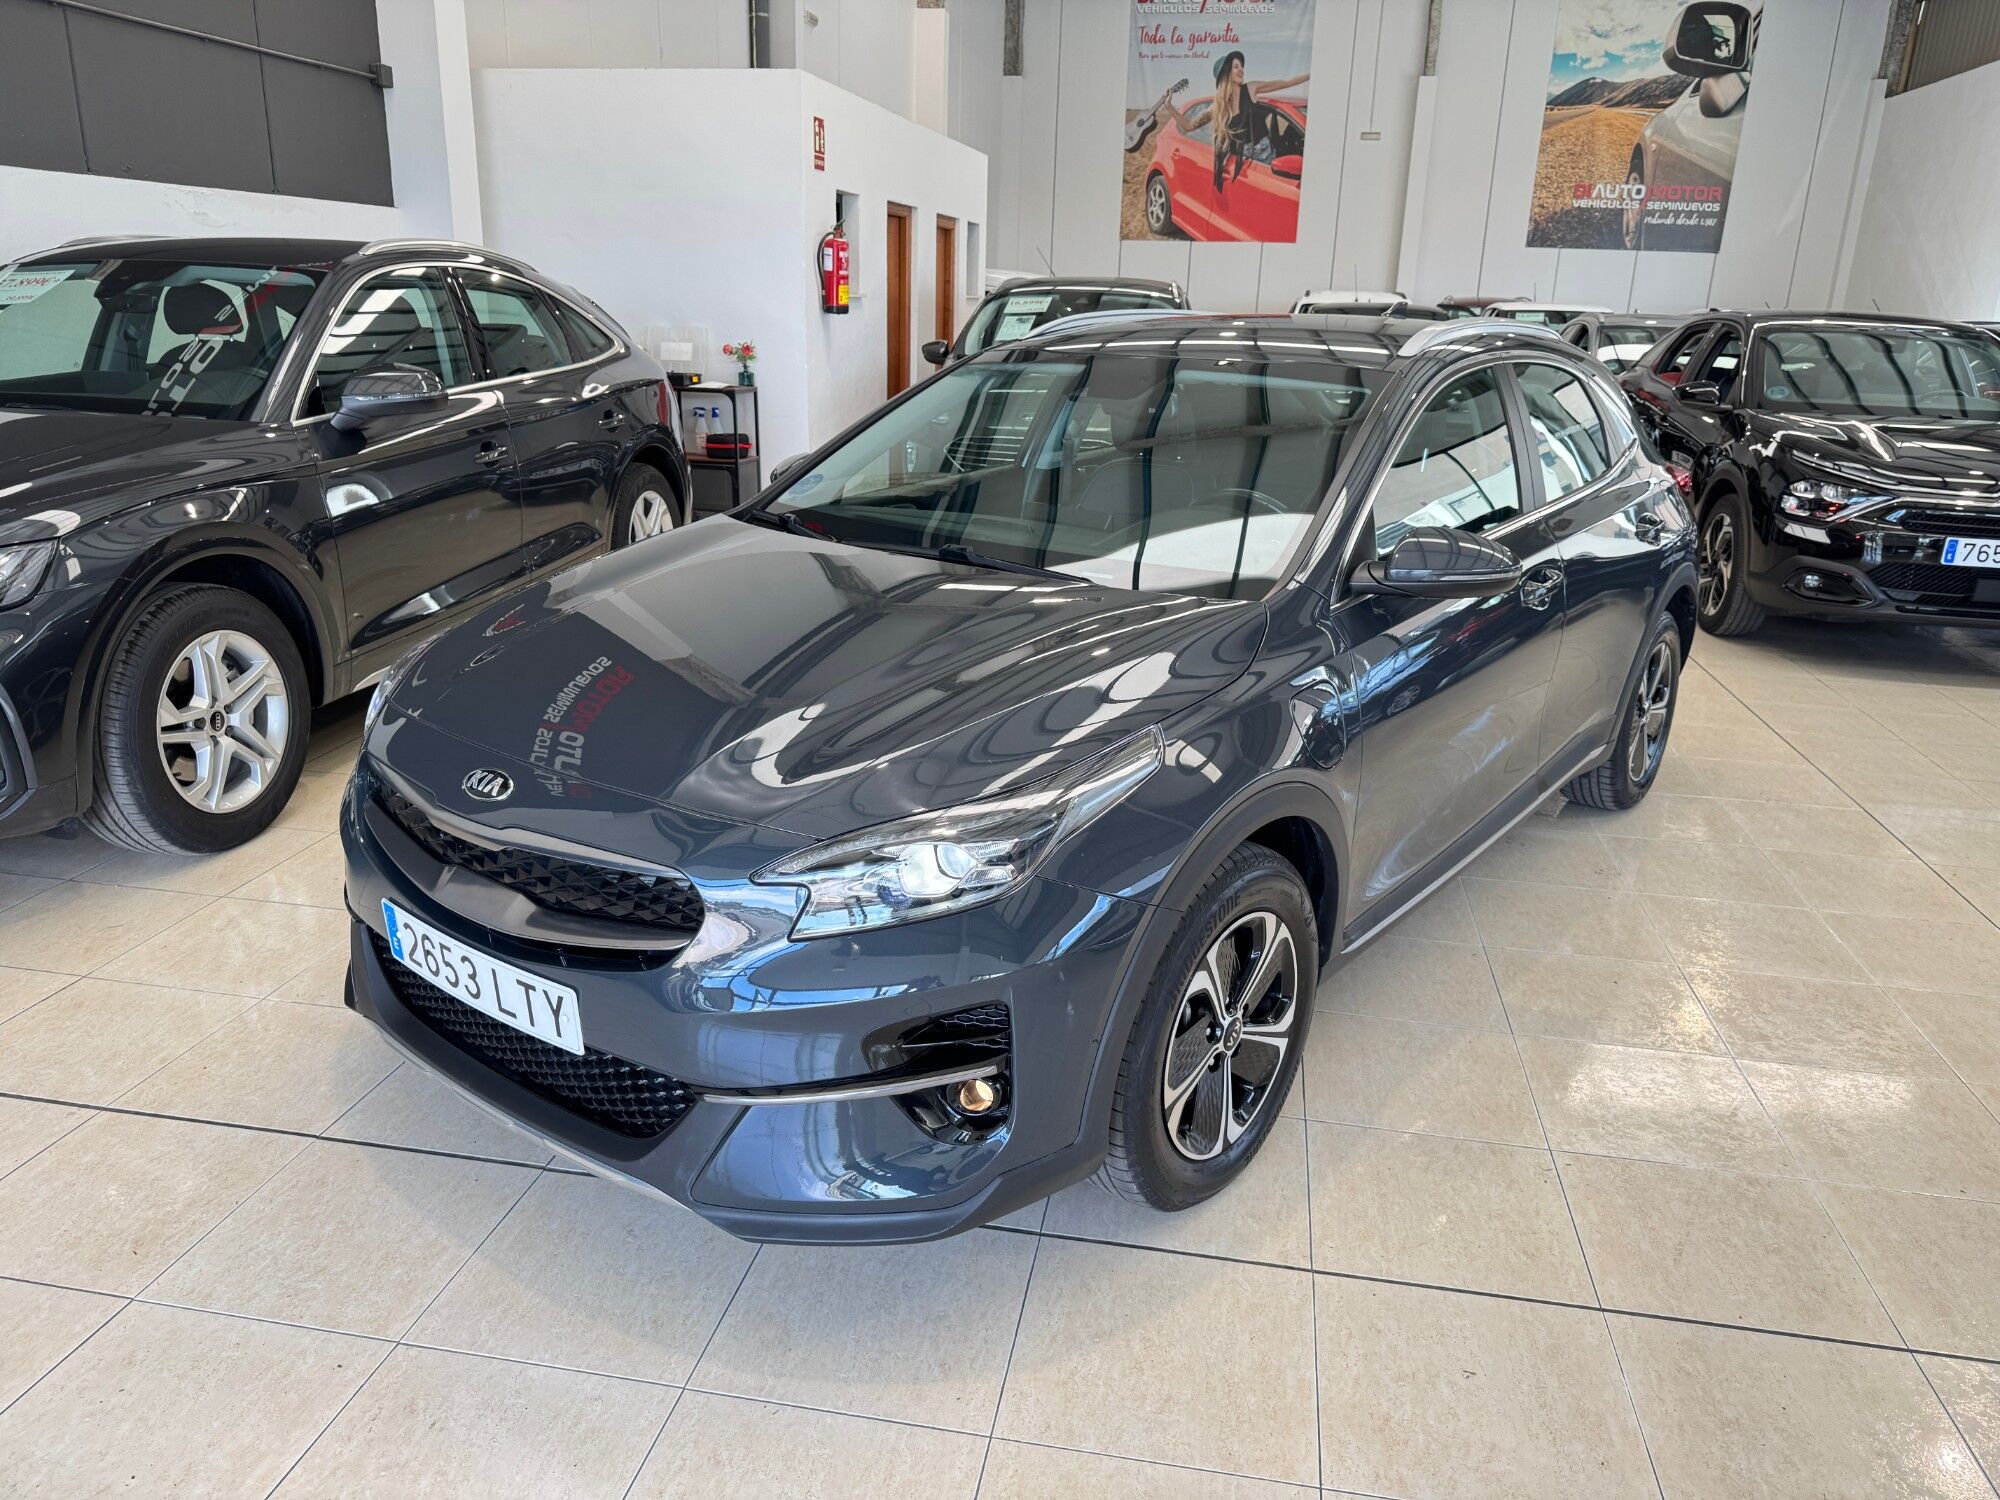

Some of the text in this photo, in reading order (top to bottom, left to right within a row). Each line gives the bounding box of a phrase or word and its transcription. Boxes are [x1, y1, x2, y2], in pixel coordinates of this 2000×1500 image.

[1138, 24, 1167, 45] Toda
[1171, 26, 1184, 45] la
[1646, 201, 1721, 212] SEMINUEVOS
[466, 769, 505, 797] KIA
[402, 921, 564, 1039] 2653 LTY
